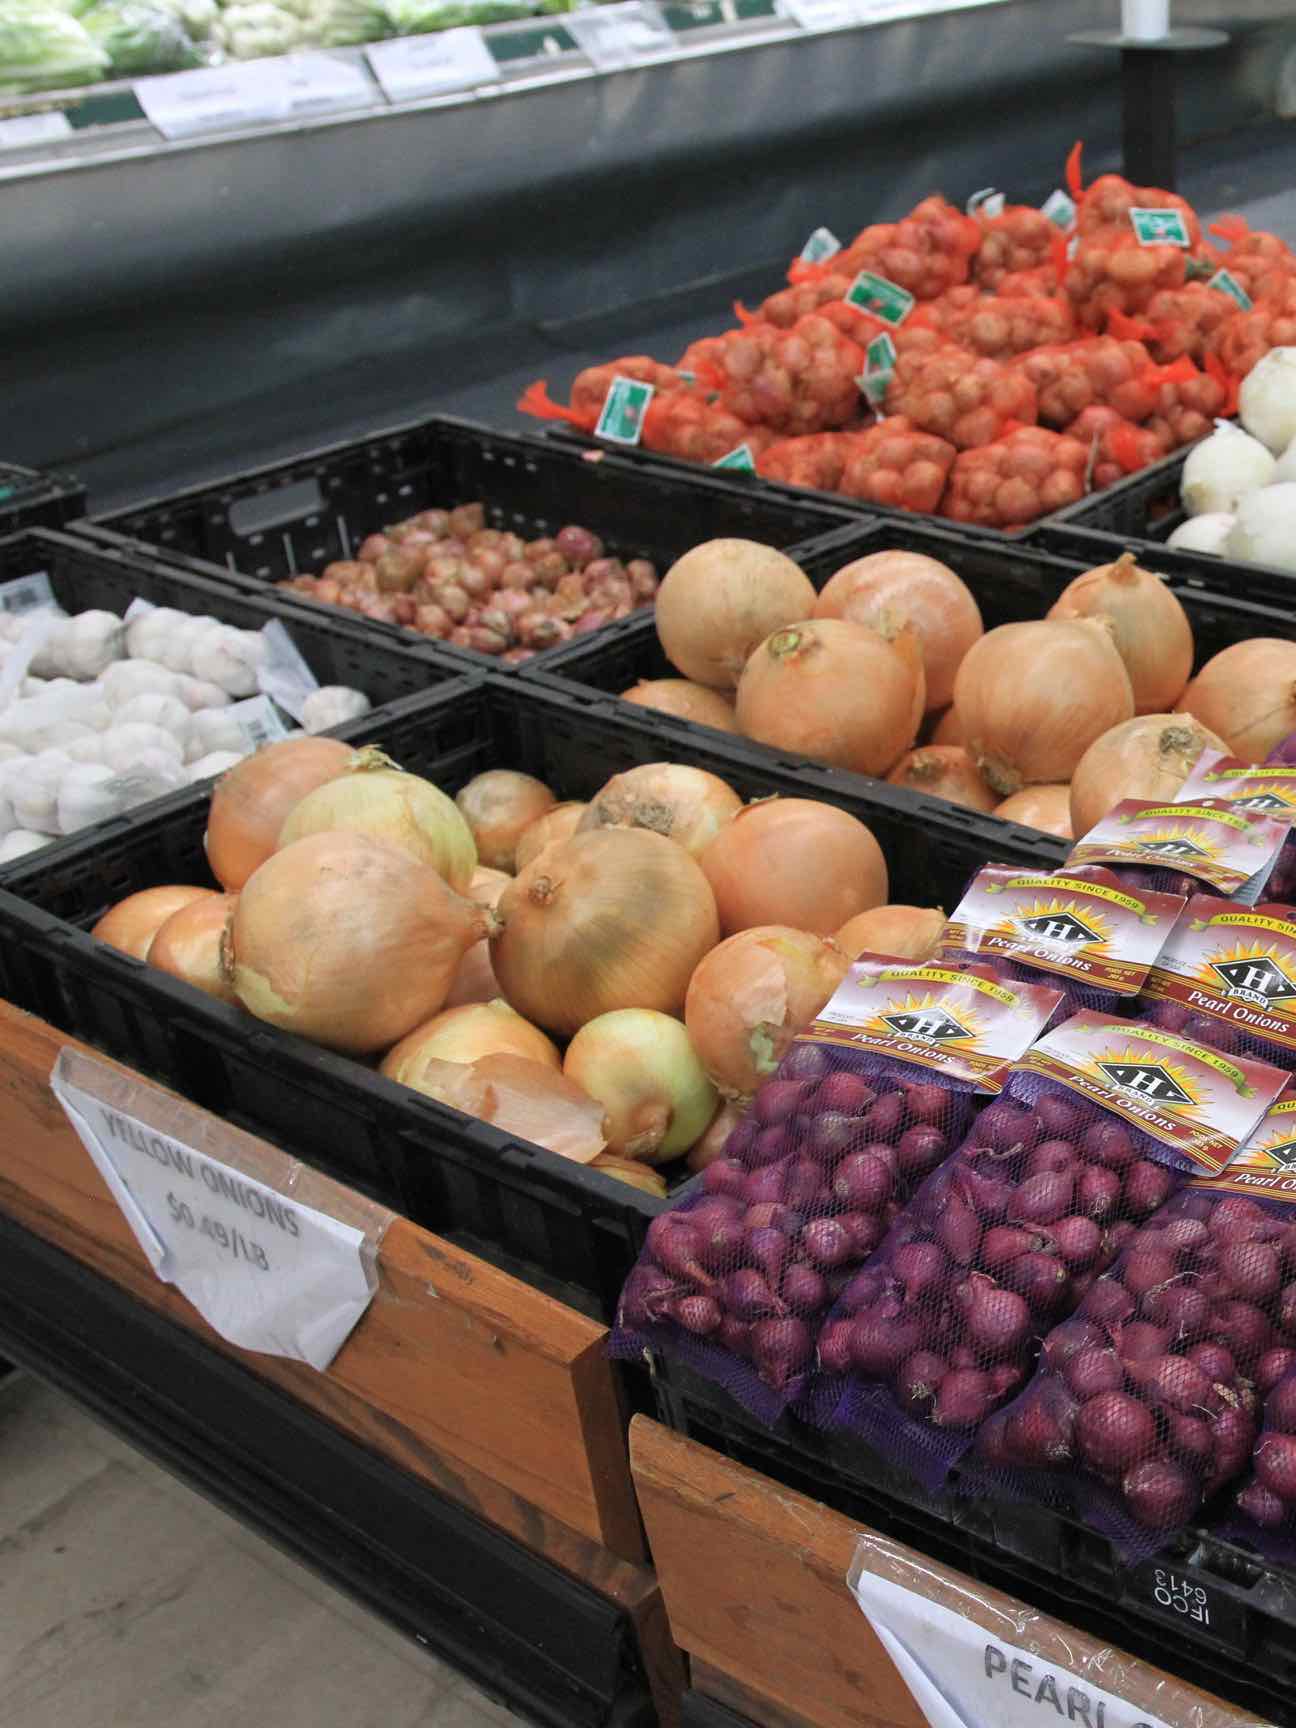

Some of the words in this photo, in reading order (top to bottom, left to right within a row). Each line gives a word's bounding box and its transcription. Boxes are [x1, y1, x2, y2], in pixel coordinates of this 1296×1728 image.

[1017, 878, 1071, 888] QUALITY
[1073, 880, 1109, 896] SINCE
[1041, 921, 1076, 941] H
[1220, 914, 1274, 927] QUALITY
[989, 936, 1030, 955] Pearl
[1031, 947, 1093, 972] Onions
[891, 969, 946, 979] QUALITY
[1240, 965, 1276, 994] H
[1233, 988, 1267, 1005] BRAND
[1188, 989, 1232, 1015] Pearl
[1233, 1006, 1290, 1033] Onions
[908, 1016, 943, 1036] H
[851, 1032, 895, 1046] Pearl
[896, 1043, 958, 1064] Onions
[1124, 1068, 1166, 1096] H
[1068, 1074, 1116, 1101] Pearl
[1115, 1098, 1176, 1132] Onions
[100, 1109, 194, 1180] YELLOW
[200, 1162, 301, 1238] ONIONS
[1234, 1173, 1280, 1189] Pearl
[1154, 1569, 1207, 1606] 6413
[1154, 1587, 1210, 1625] IFCO
